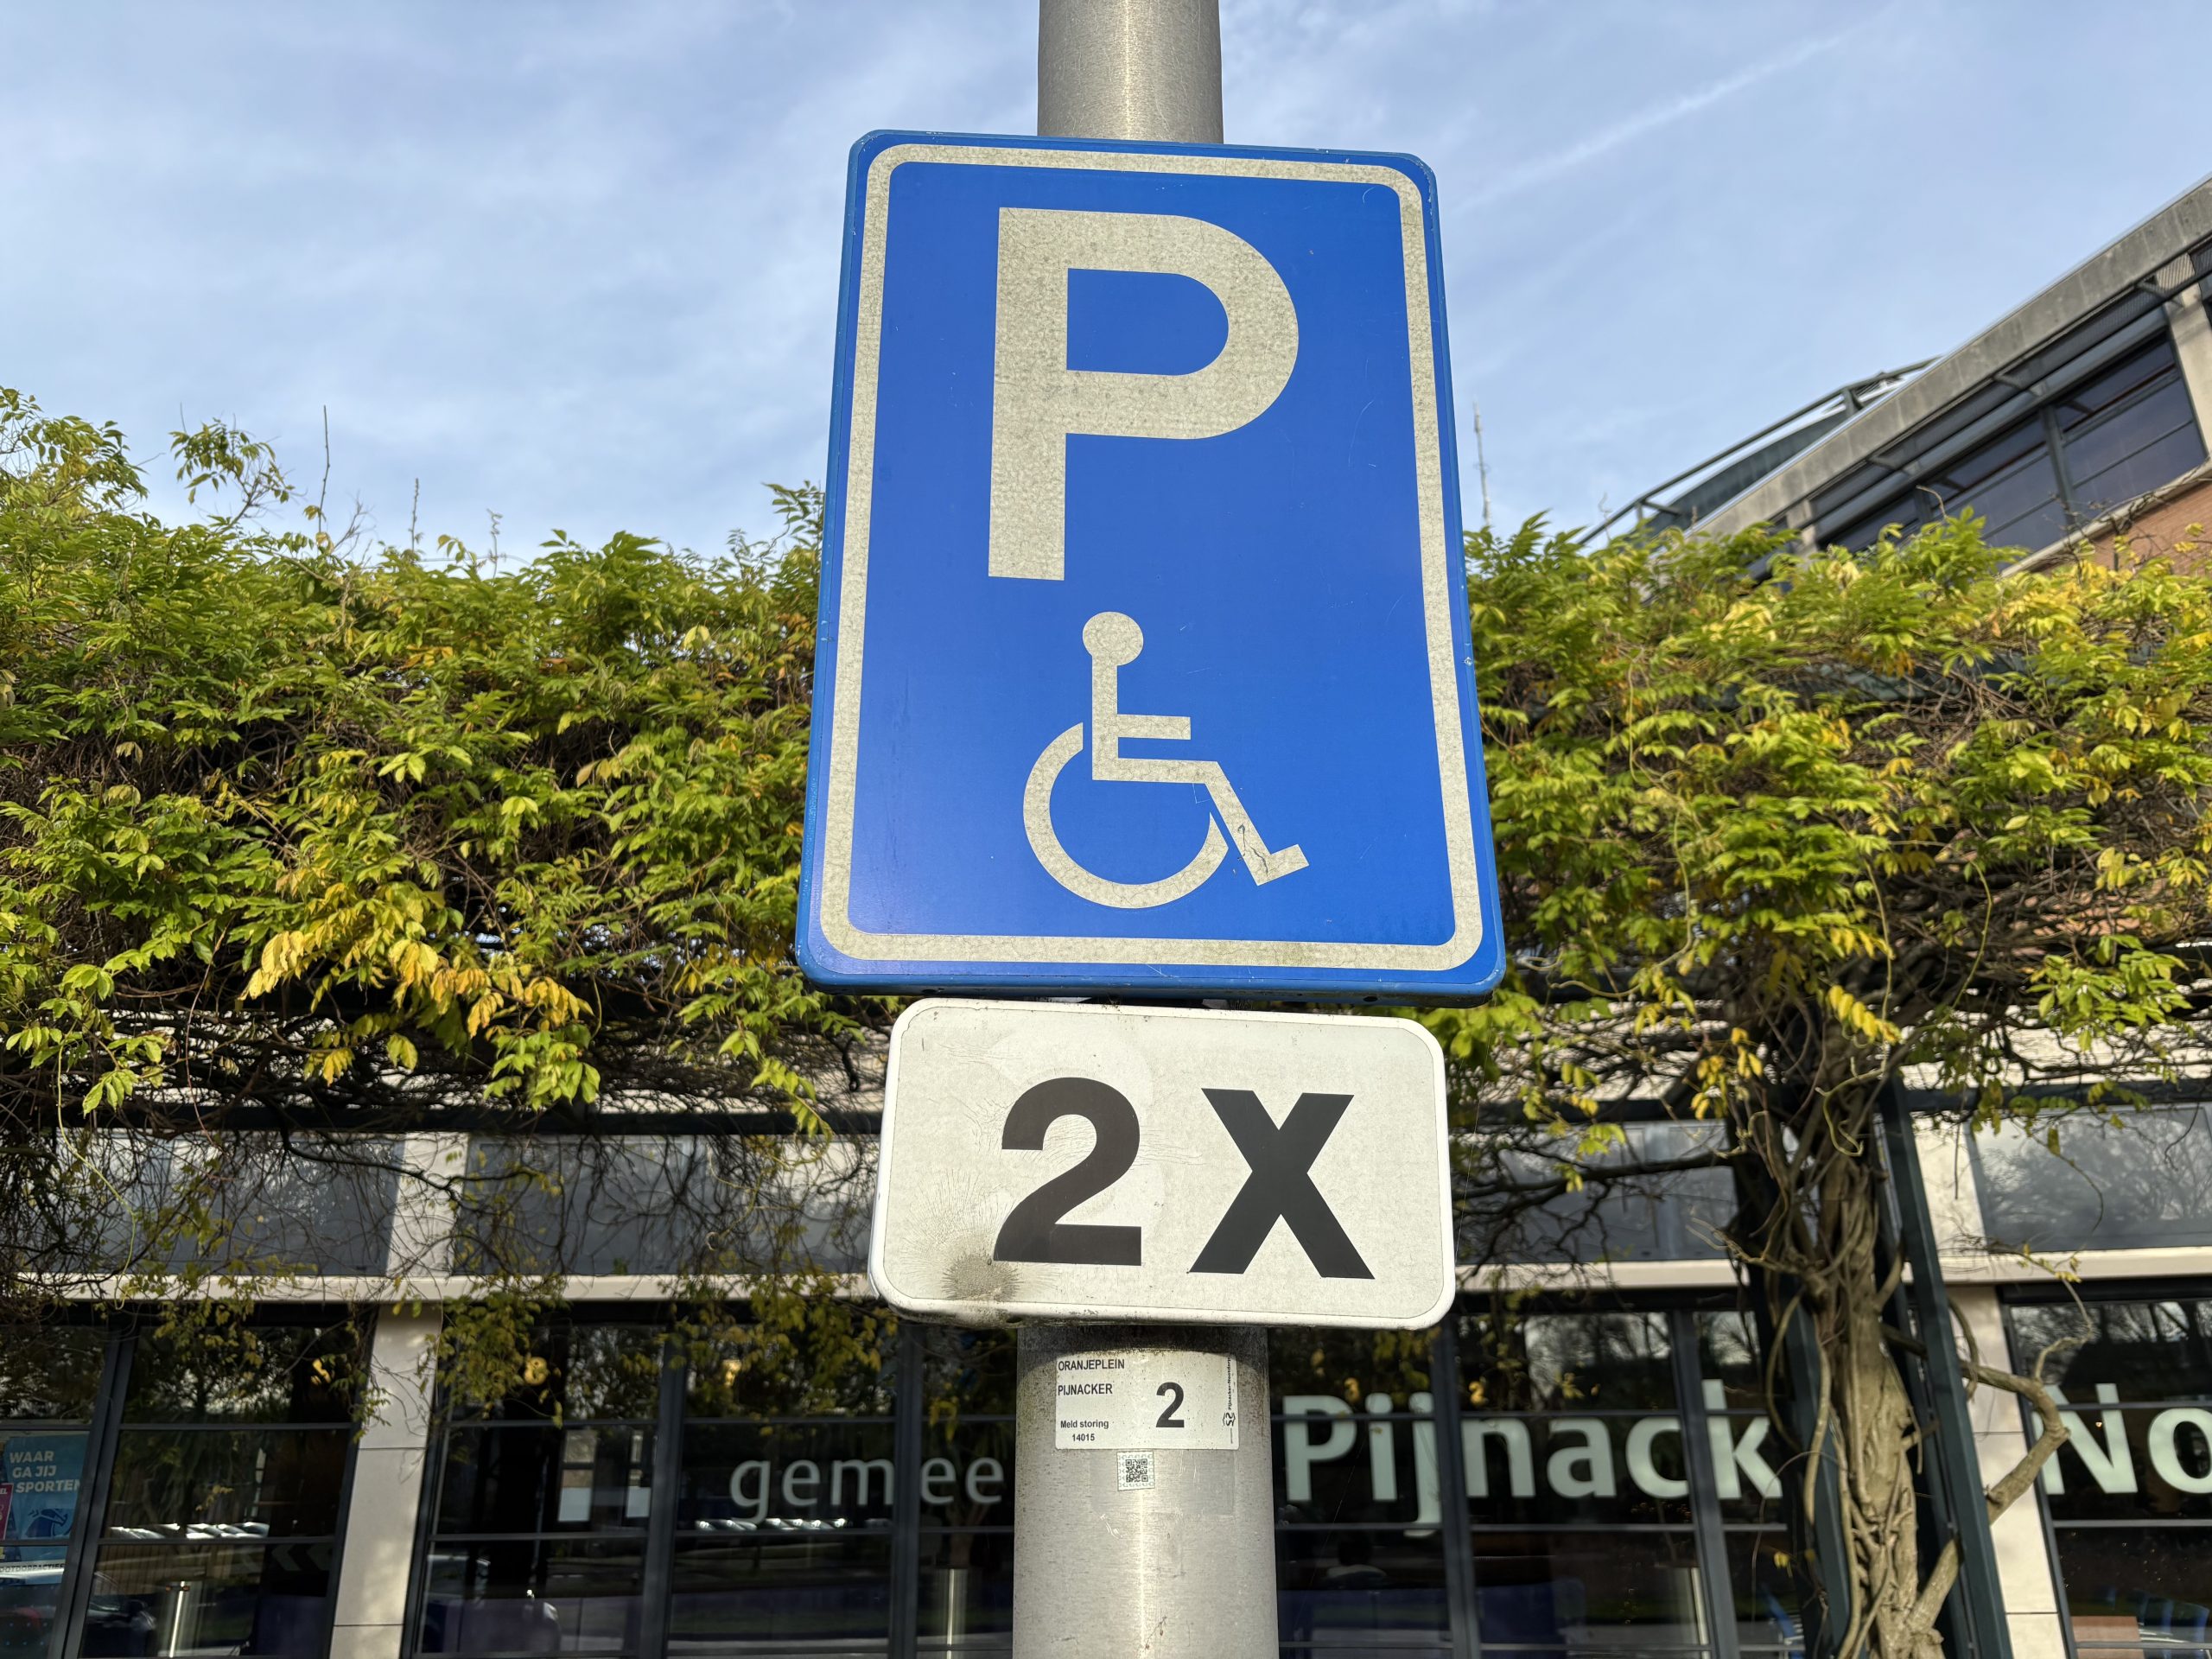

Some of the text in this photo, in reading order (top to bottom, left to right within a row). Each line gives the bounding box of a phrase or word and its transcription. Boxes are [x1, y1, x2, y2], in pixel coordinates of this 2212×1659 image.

[988, 207, 1300, 582] P
[1058, 1358, 1125, 1371] ORANJEPLEIN
[1058, 1383, 1113, 1396] PIJNACKER
[1155, 1382, 1185, 1428] 2
[1060, 1419, 1109, 1429] Meld storing
[1071, 1433, 1096, 1442] 14015
[10, 1451, 54, 1464] WAAR
[12, 1465, 57, 1478] GA JIJ
